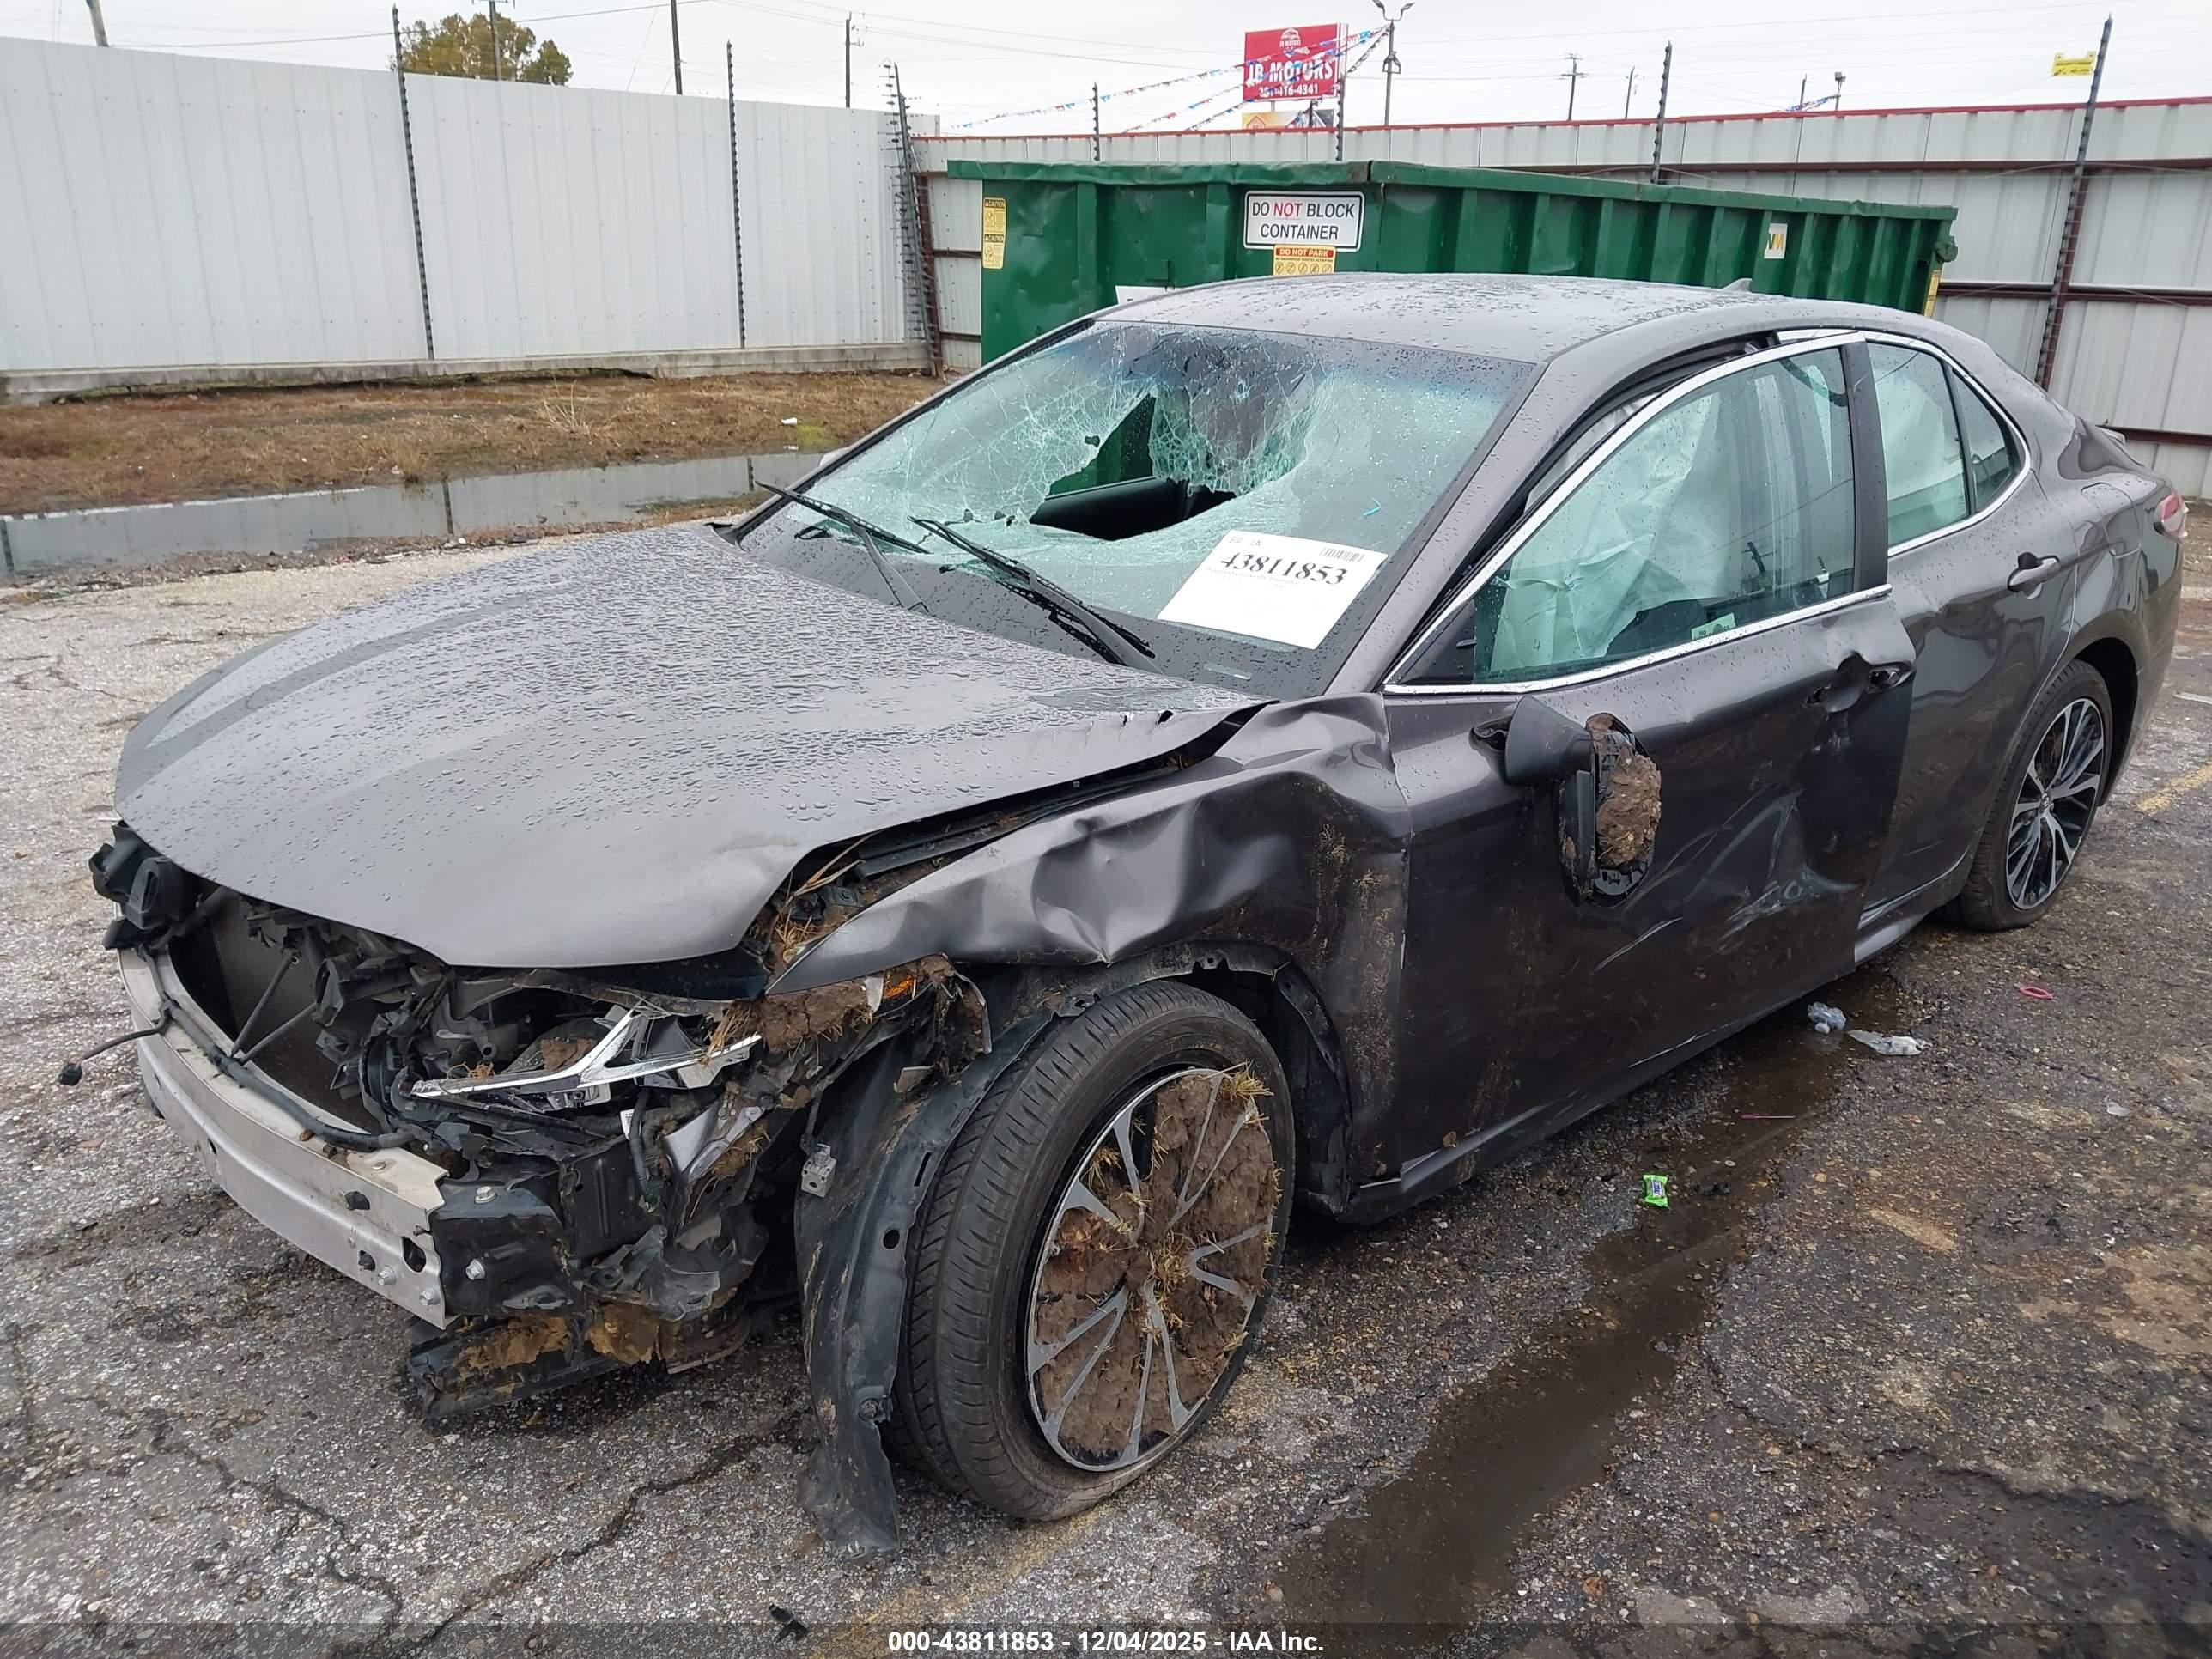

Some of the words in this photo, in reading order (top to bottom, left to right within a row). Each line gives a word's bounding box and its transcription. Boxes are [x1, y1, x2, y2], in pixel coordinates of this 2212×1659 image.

[1268, 60, 1333, 83] MOTORS
[1252, 202, 1270, 216] DO
[1273, 202, 1303, 217] NOT
[1307, 203, 1355, 218] BLOCK
[1260, 223, 1339, 240] CONTAINER
[1221, 552, 1348, 586] 43811853
